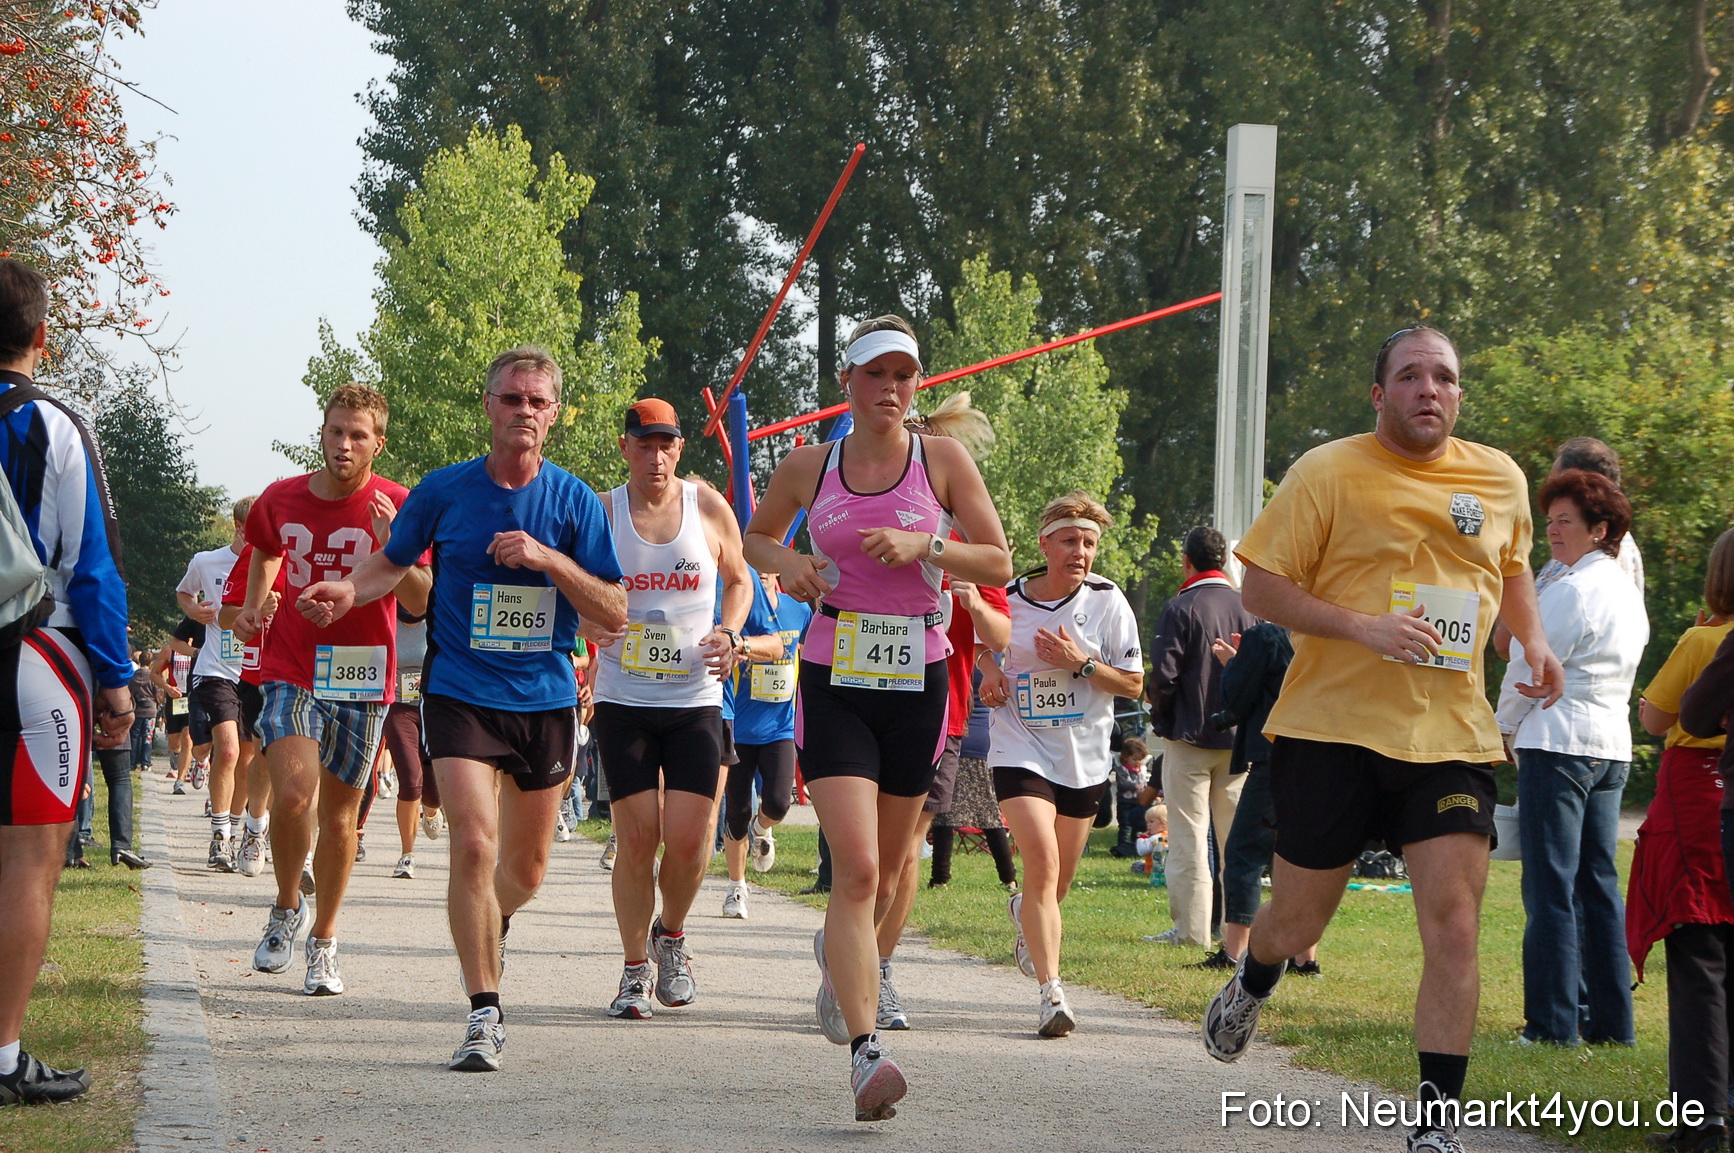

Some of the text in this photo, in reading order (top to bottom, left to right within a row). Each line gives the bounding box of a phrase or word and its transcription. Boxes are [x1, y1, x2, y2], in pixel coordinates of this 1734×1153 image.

[313, 553, 336, 562] RIU
[622, 572, 700, 592] OSRAM
[497, 591, 522, 604] Hans
[477, 608, 546, 628] C 2665
[861, 619, 908, 635] Barbara
[644, 628, 666, 641] Sven
[626, 642, 632, 651] C
[648, 646, 682, 664] 934
[838, 638, 911, 666] C 415
[335, 666, 377, 681] 3883
[764, 668, 778, 676] Mike
[772, 680, 786, 690] 52
[888, 678, 923, 686] PFLEIDERER
[1033, 677, 1057, 688] Paula
[1020, 692, 1075, 708] C 3491
[1440, 796, 1478, 810] RANGER
